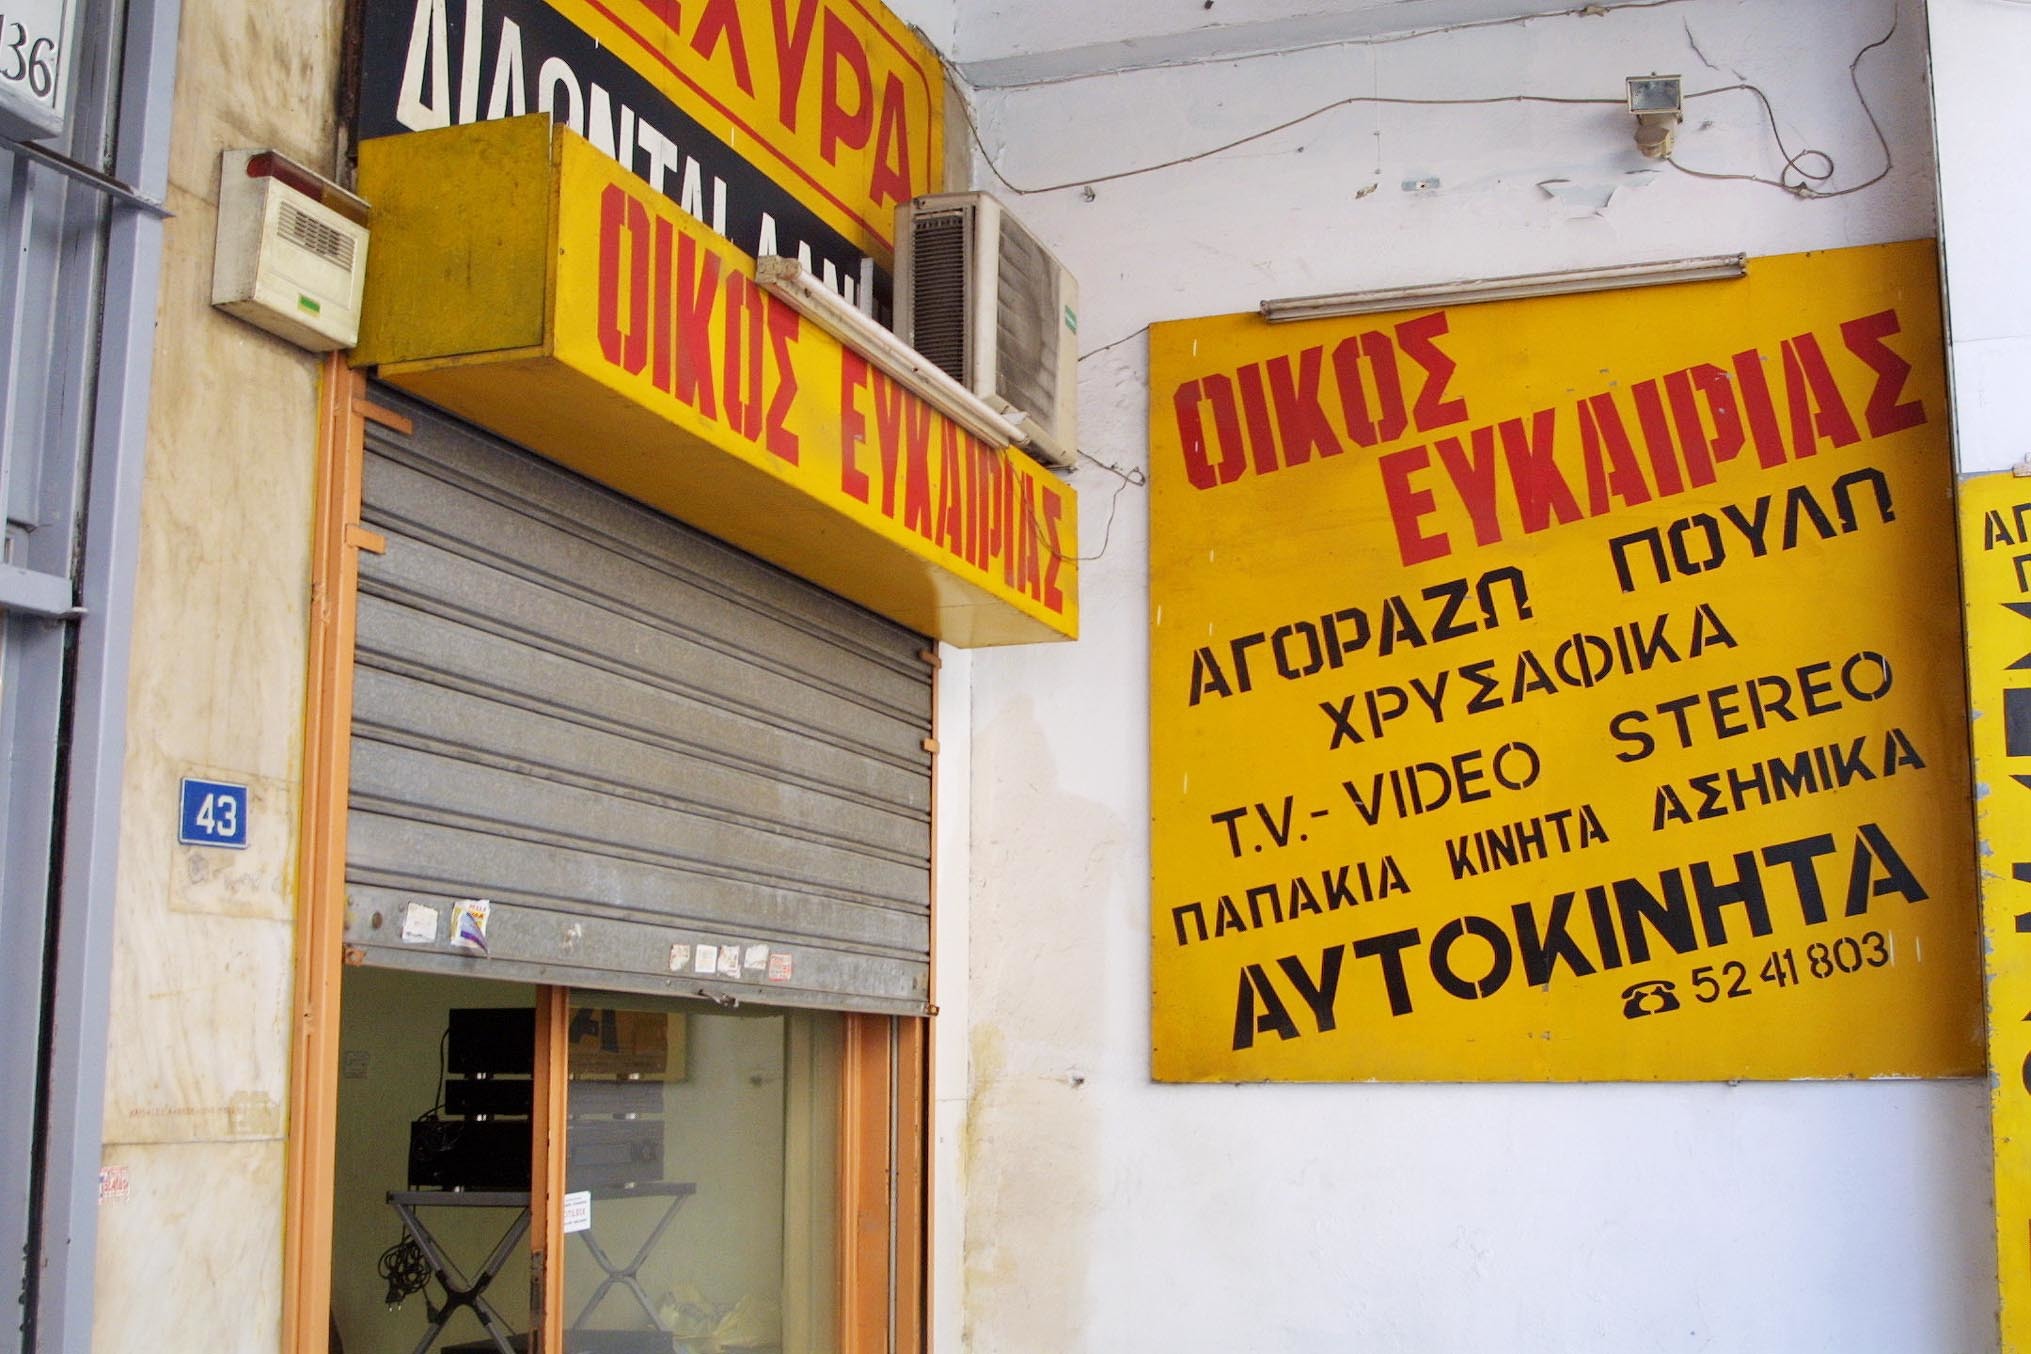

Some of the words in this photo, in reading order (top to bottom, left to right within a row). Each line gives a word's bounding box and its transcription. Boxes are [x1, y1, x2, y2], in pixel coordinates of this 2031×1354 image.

[639, 0, 912, 209] ΧΥΡΑ
[598, 182, 801, 467] ΟΙΚΟΣ
[841, 343, 1064, 615] ΕΥΚΑΙΡΙΑΣ
[1174, 311, 1469, 491] ΟΙΚΟΣ
[1379, 309, 1928, 567] ΕΥΚΑΙΡΙΑΣ
[1188, 565, 1534, 706] ΑΓΟΡΑΖΩ
[1608, 467, 1896, 594] ΠΟΥΛΩ
[1319, 602, 1739, 750] ΧΡΥΣΑΦΙΚΑ
[1609, 650, 1895, 763] STEREO
[196, 792, 238, 837] 43
[1171, 855, 1412, 947] ΠΑΠΑΚΙΑ
[1445, 803, 1610, 880] ΚΙΝΗΤΑ
[1651, 727, 1926, 832] ΑΣΗΜΙΚΑ
[1231, 821, 1930, 1052] ΑΥΤΟΚΙΝΗΤΑ
